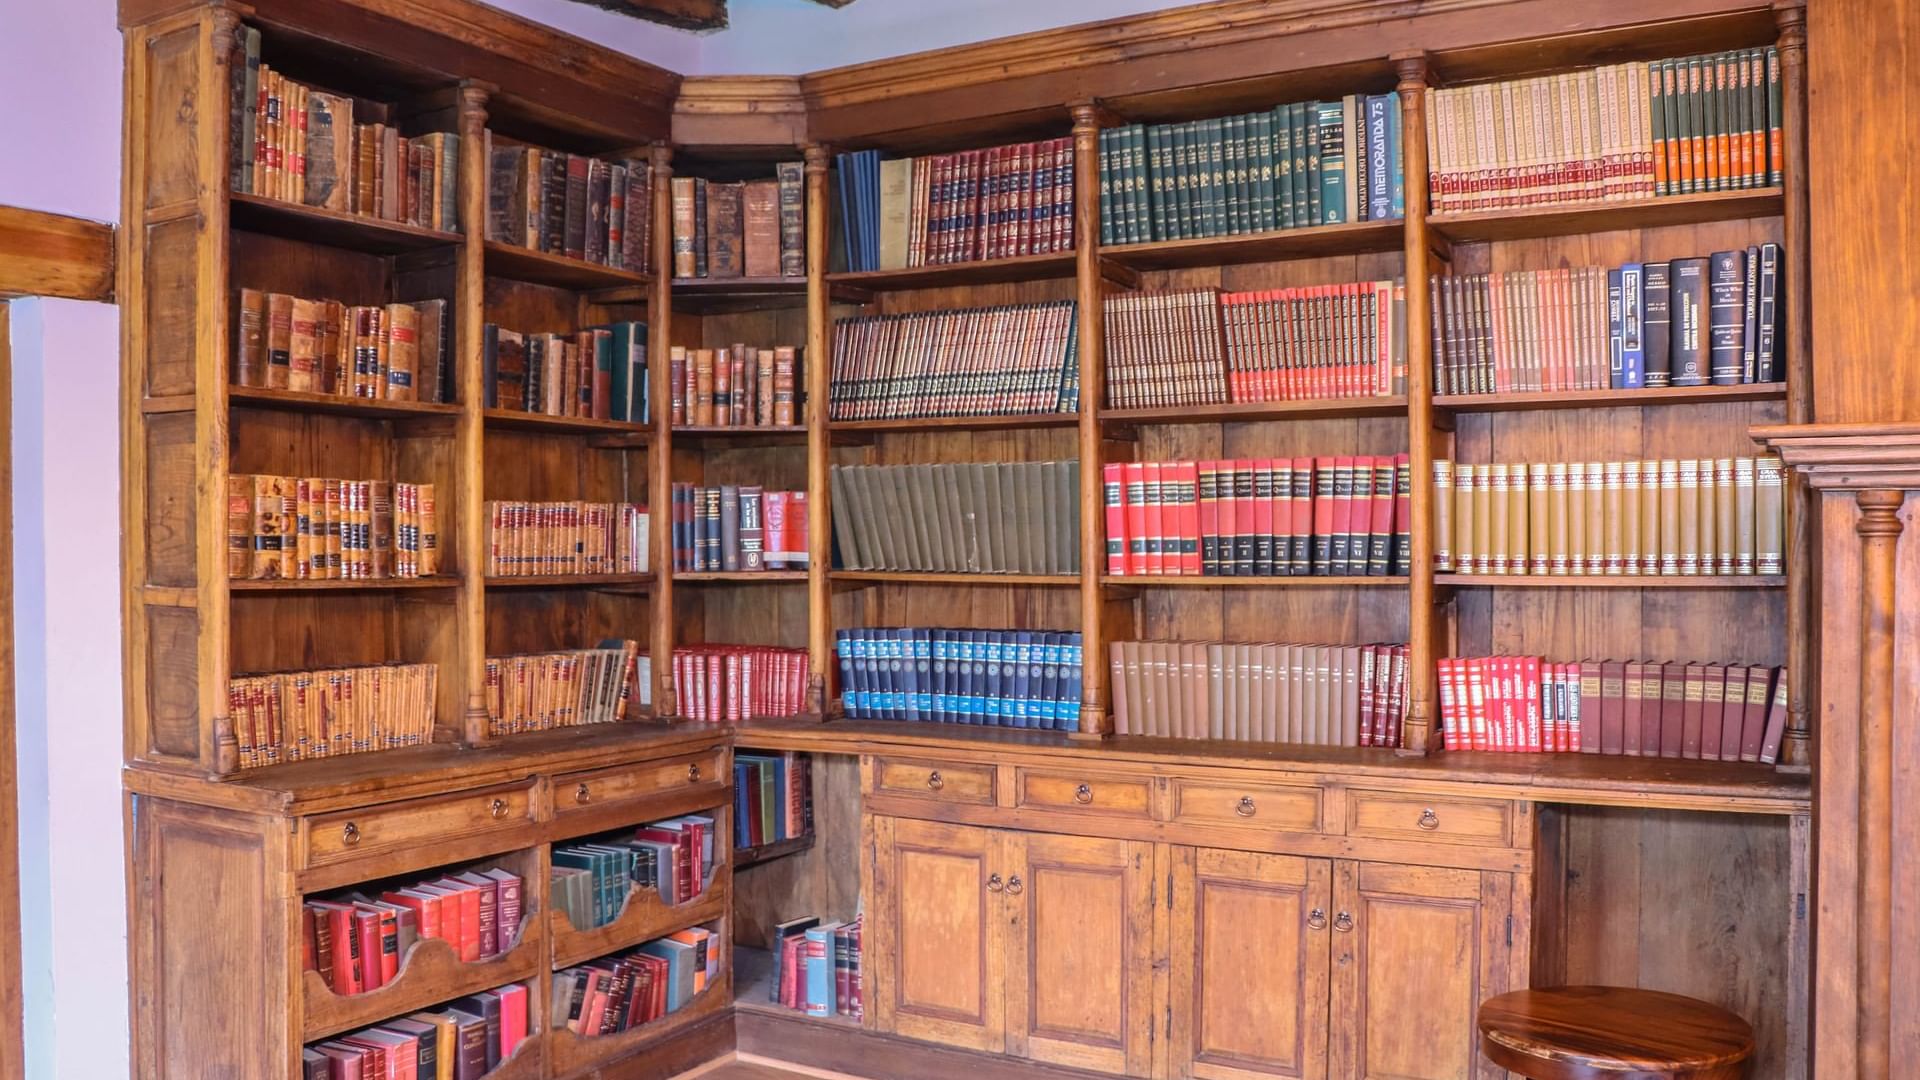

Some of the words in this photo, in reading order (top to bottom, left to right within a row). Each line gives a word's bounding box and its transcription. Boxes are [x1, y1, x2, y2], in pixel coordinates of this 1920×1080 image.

[1372, 102, 1384, 117] 75
[1358, 119, 1367, 157] INTERIOR
[1373, 118, 1386, 195] MEMORANDA
[1359, 158, 1368, 209] DECORATION
